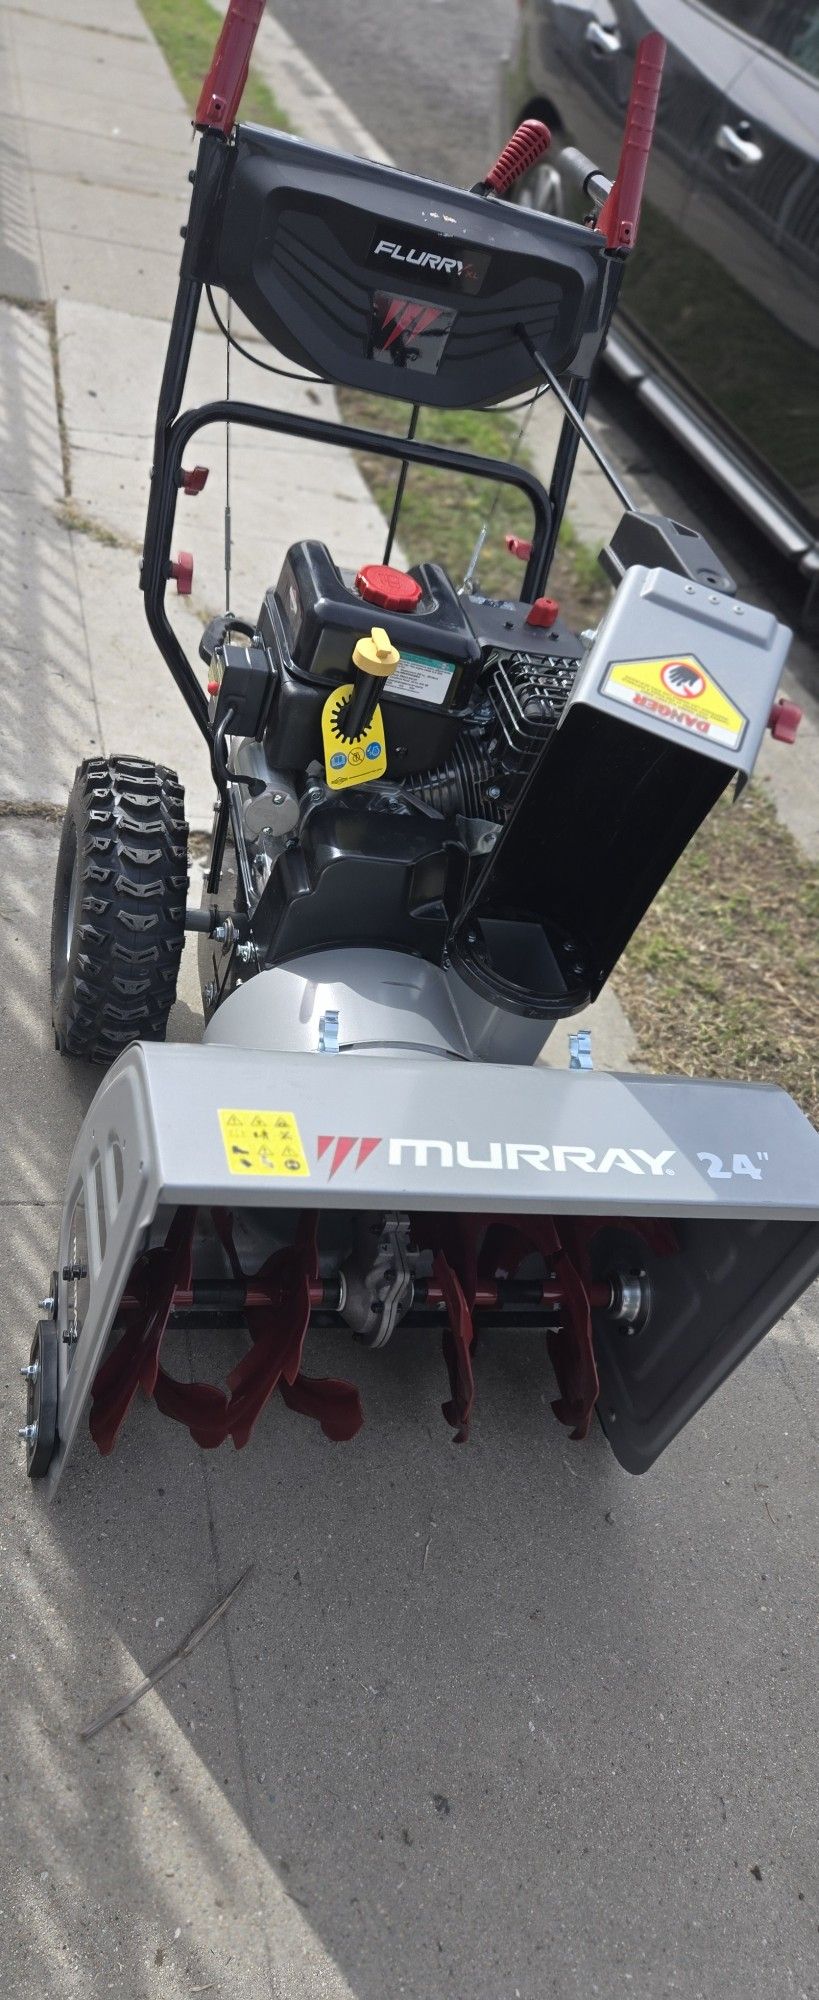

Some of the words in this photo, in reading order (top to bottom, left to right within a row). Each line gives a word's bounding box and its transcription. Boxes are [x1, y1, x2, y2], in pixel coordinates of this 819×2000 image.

[374, 240, 472, 276] FLURRY
[632, 693, 711, 734] DANGER
[388, 1137, 676, 1176] MURRAY
[696, 1150, 769, 1180] 24"
